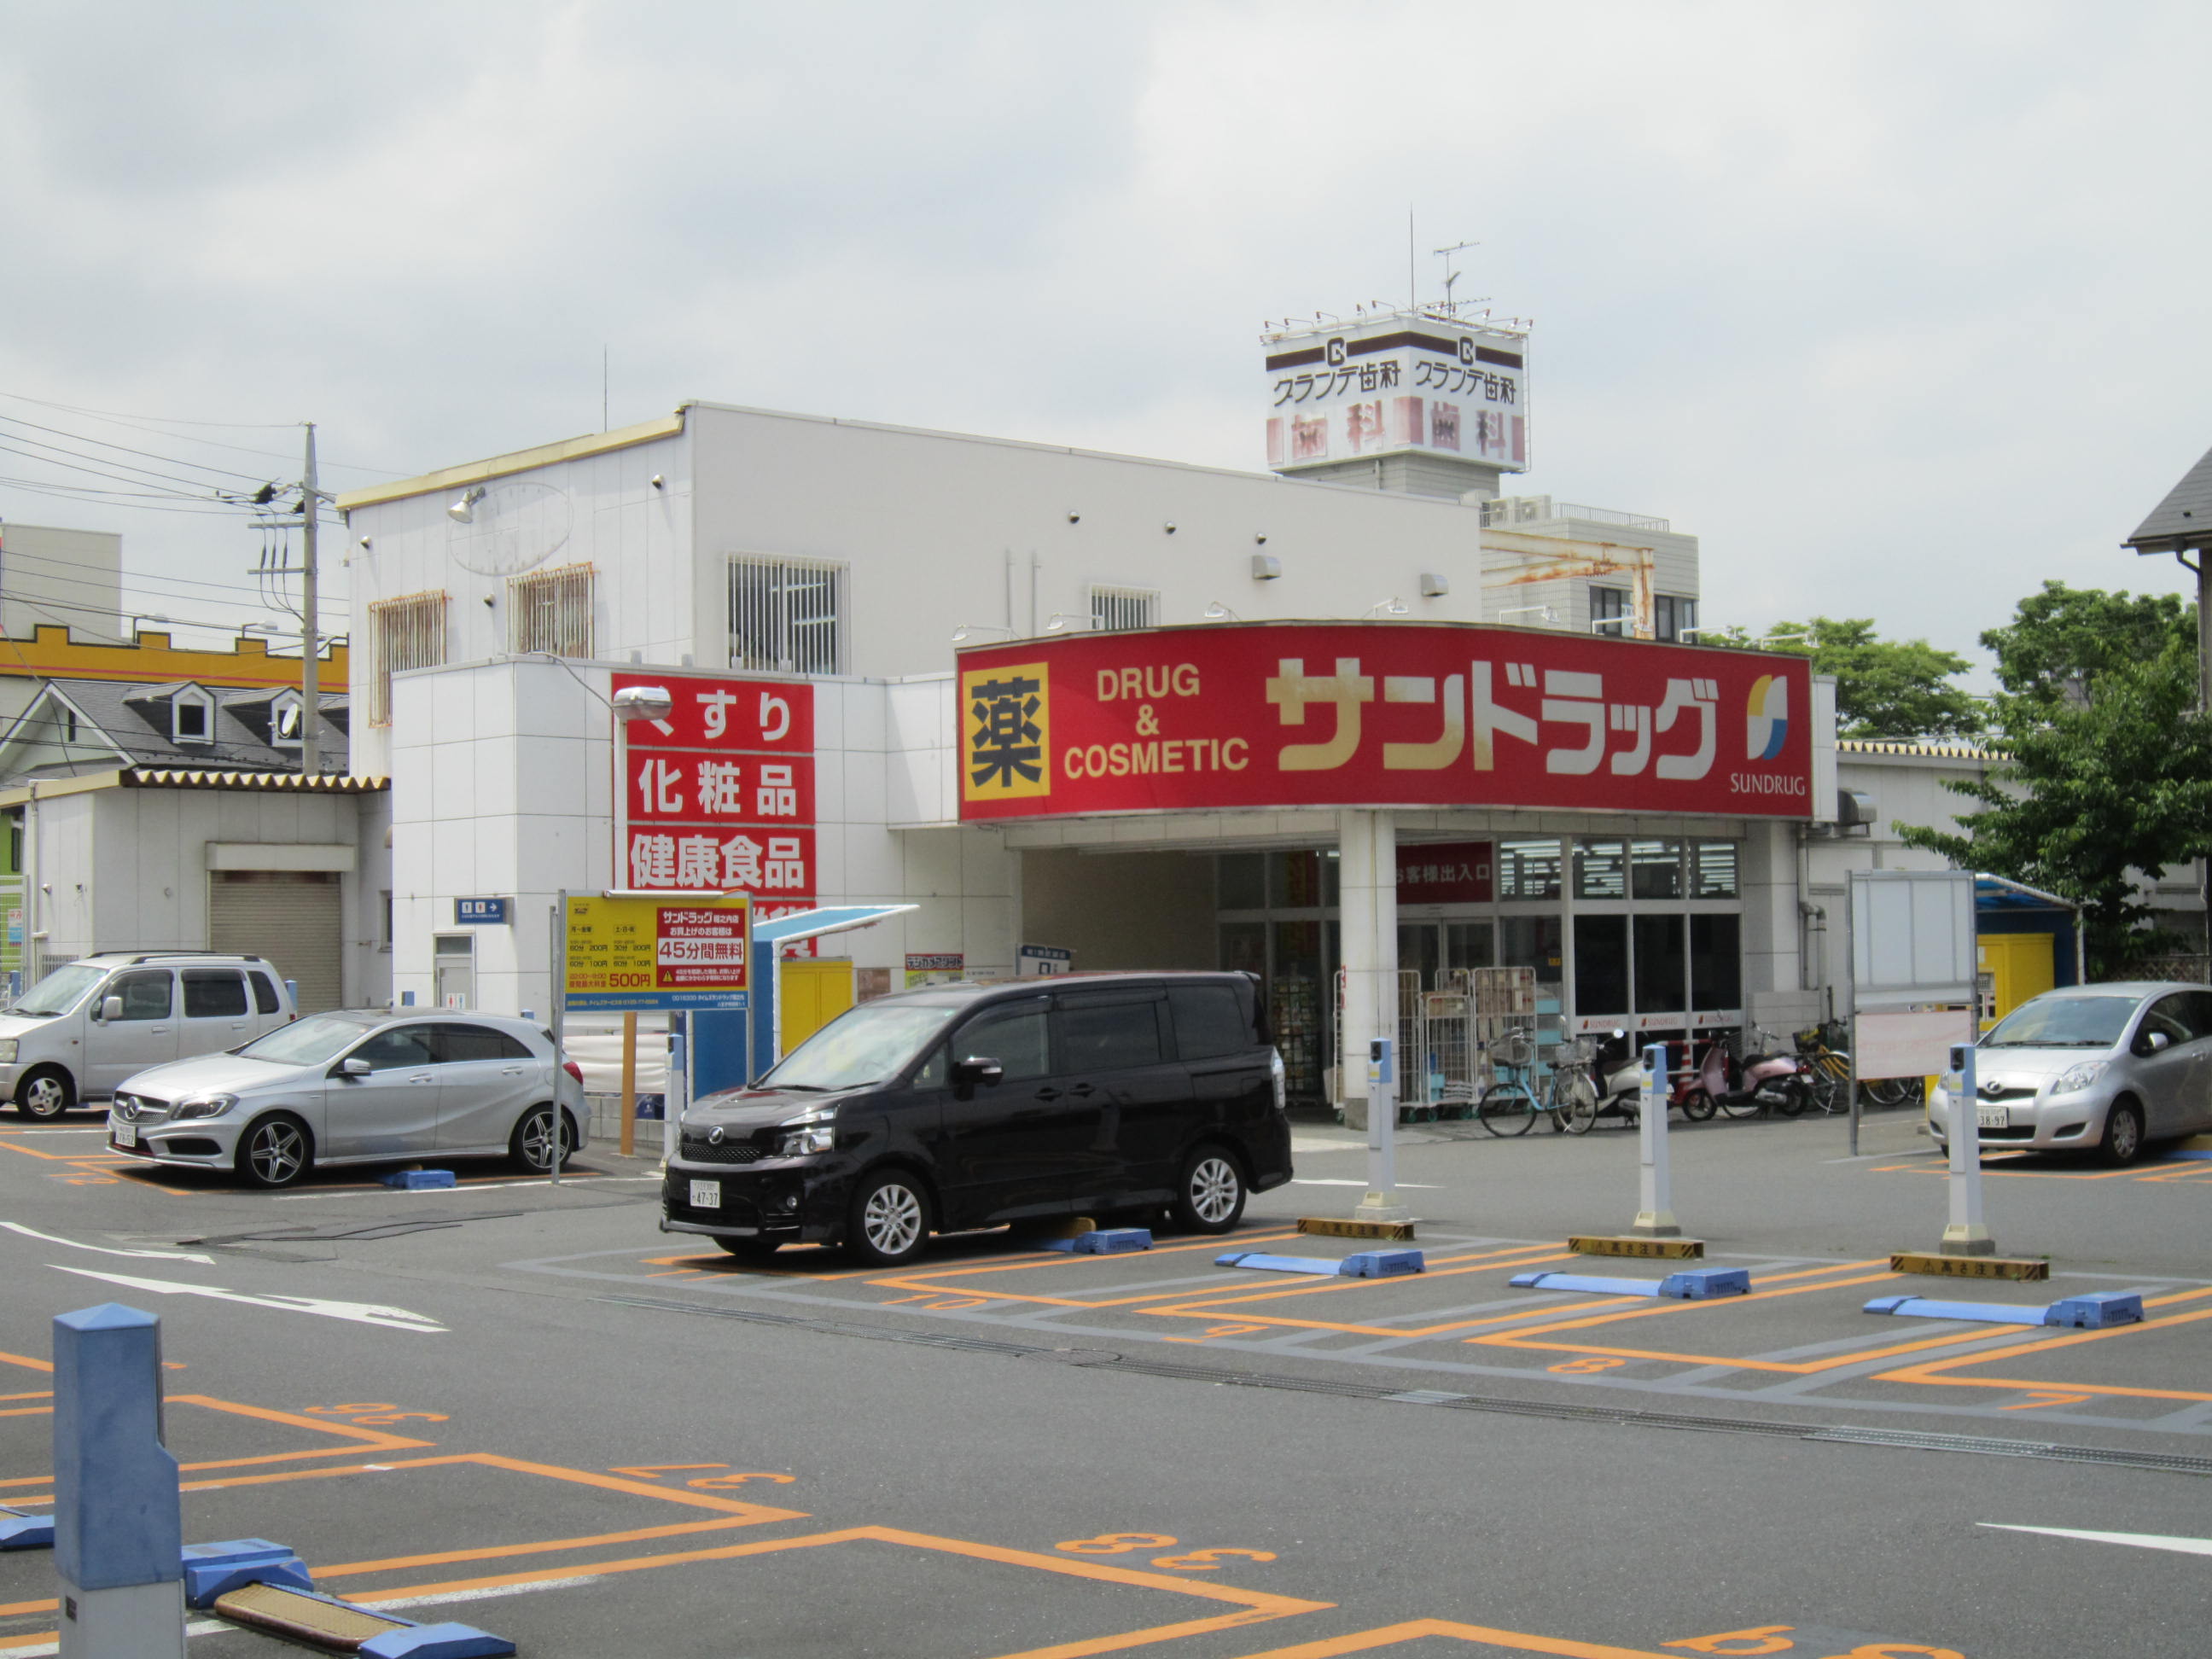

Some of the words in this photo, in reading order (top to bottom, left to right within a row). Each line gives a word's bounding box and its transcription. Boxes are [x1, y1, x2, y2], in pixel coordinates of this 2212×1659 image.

[1097, 663, 1200, 701] DRUG
[969, 675, 1043, 789] 薬
[1135, 703, 1160, 736] &
[1266, 657, 1720, 781] サンドラッグ
[1063, 737, 1249, 779] COSMETIC
[638, 758, 797, 816] 化粧品
[1730, 771, 1807, 796] SUNDRUG
[631, 833, 805, 889] 健康食品
[663, 911, 713, 923] サンドラッグ
[659, 941, 742, 960] 45分間無料
[609, 973, 650, 987] 500円
[697, 1191, 718, 1206] 47-37
[881, 1293, 988, 1311] 10
[1546, 1357, 1627, 1374] 8
[304, 1402, 451, 1425] 36
[2000, 1392, 2093, 1411] 7
[608, 1463, 797, 1490] 37
[1054, 1532, 1278, 1571] 38
